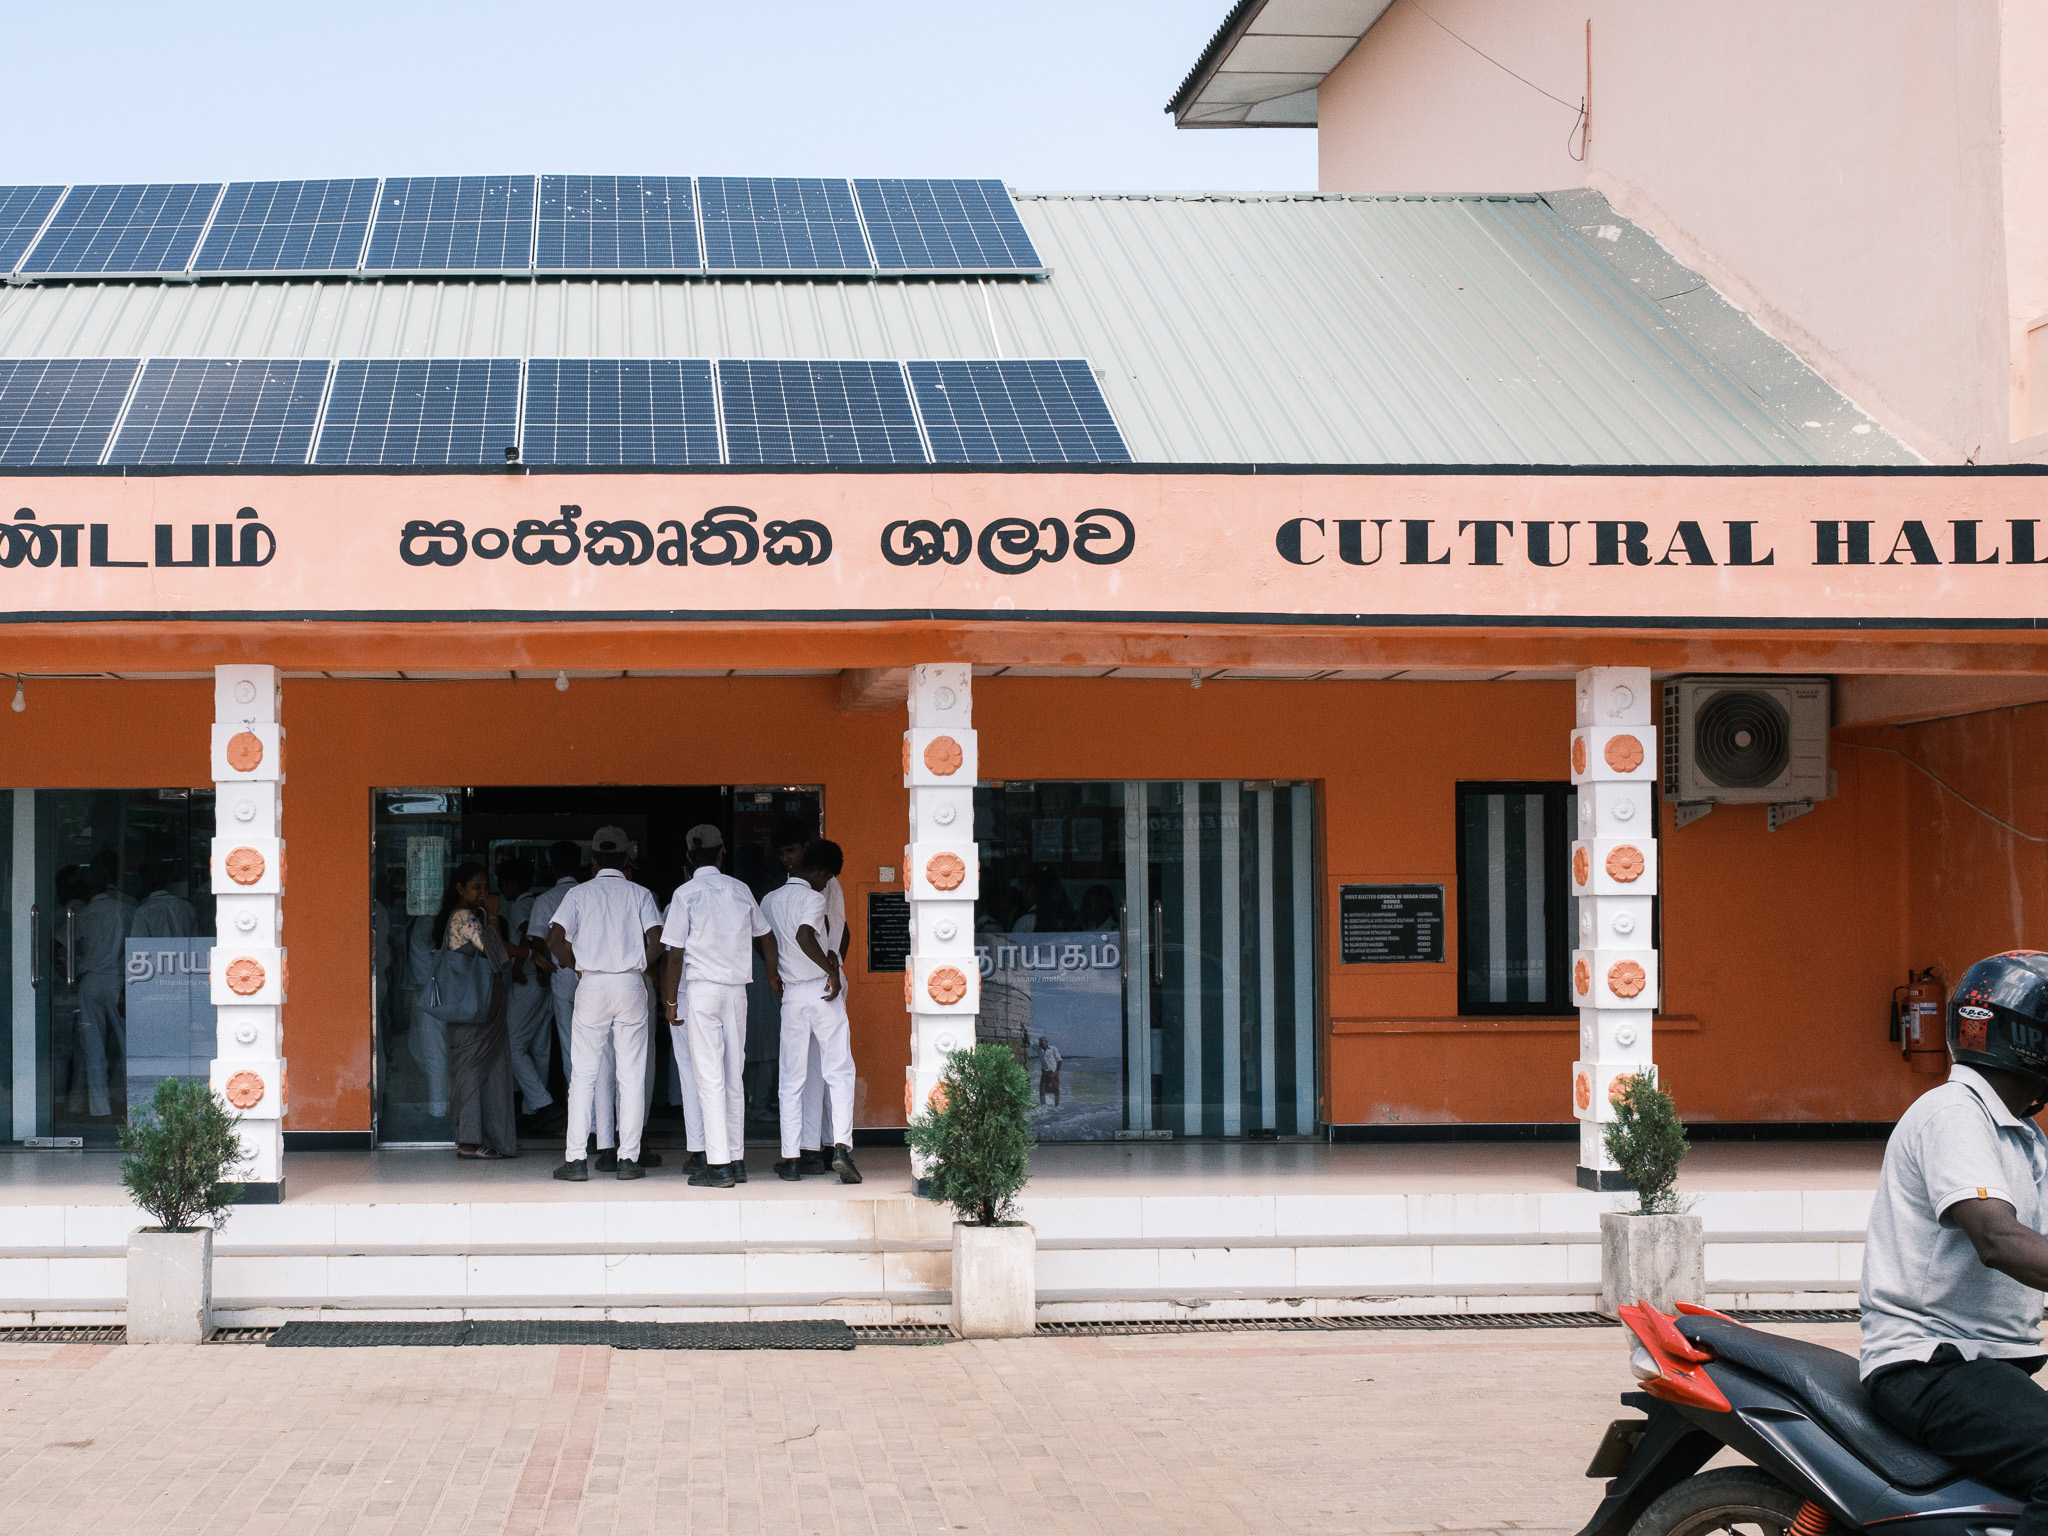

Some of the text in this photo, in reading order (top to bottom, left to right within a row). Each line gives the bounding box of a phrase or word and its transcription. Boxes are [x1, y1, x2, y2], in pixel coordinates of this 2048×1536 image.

[399, 504, 1136, 575] සංස්කෘතික ශාලාව
[1275, 517, 2048, 567] CULTURAL HALL
